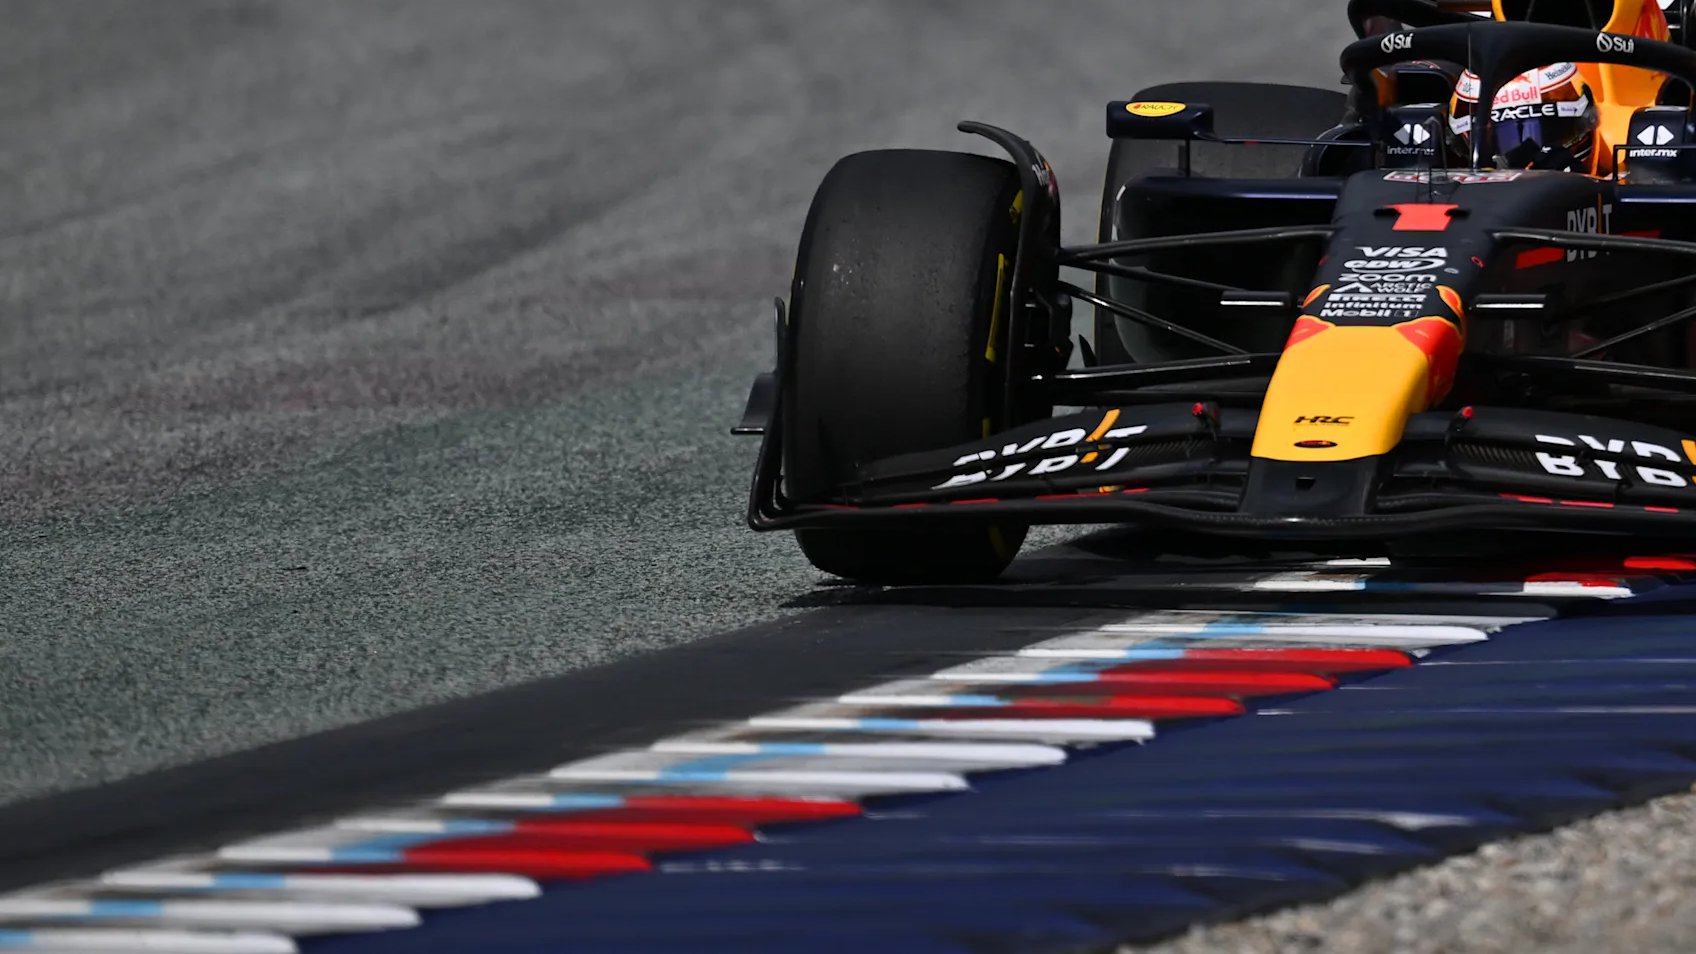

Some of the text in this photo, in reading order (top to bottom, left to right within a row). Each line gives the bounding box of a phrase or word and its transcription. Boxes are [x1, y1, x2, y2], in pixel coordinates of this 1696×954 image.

[1394, 32, 1414, 50] Sui
[1613, 36, 1635, 54] Sui
[1492, 86, 1538, 105] ed Bull
[1490, 104, 1556, 123] RACLE
[1629, 149, 1678, 157] inter.mx
[1383, 203, 1459, 231] 1
[1355, 246, 1448, 258] VISA
[1338, 273, 1437, 282] zoom
[1328, 293, 1427, 302] PIRELLI
[1320, 309, 1391, 317] Mobil
[1294, 415, 1355, 424] HRC
